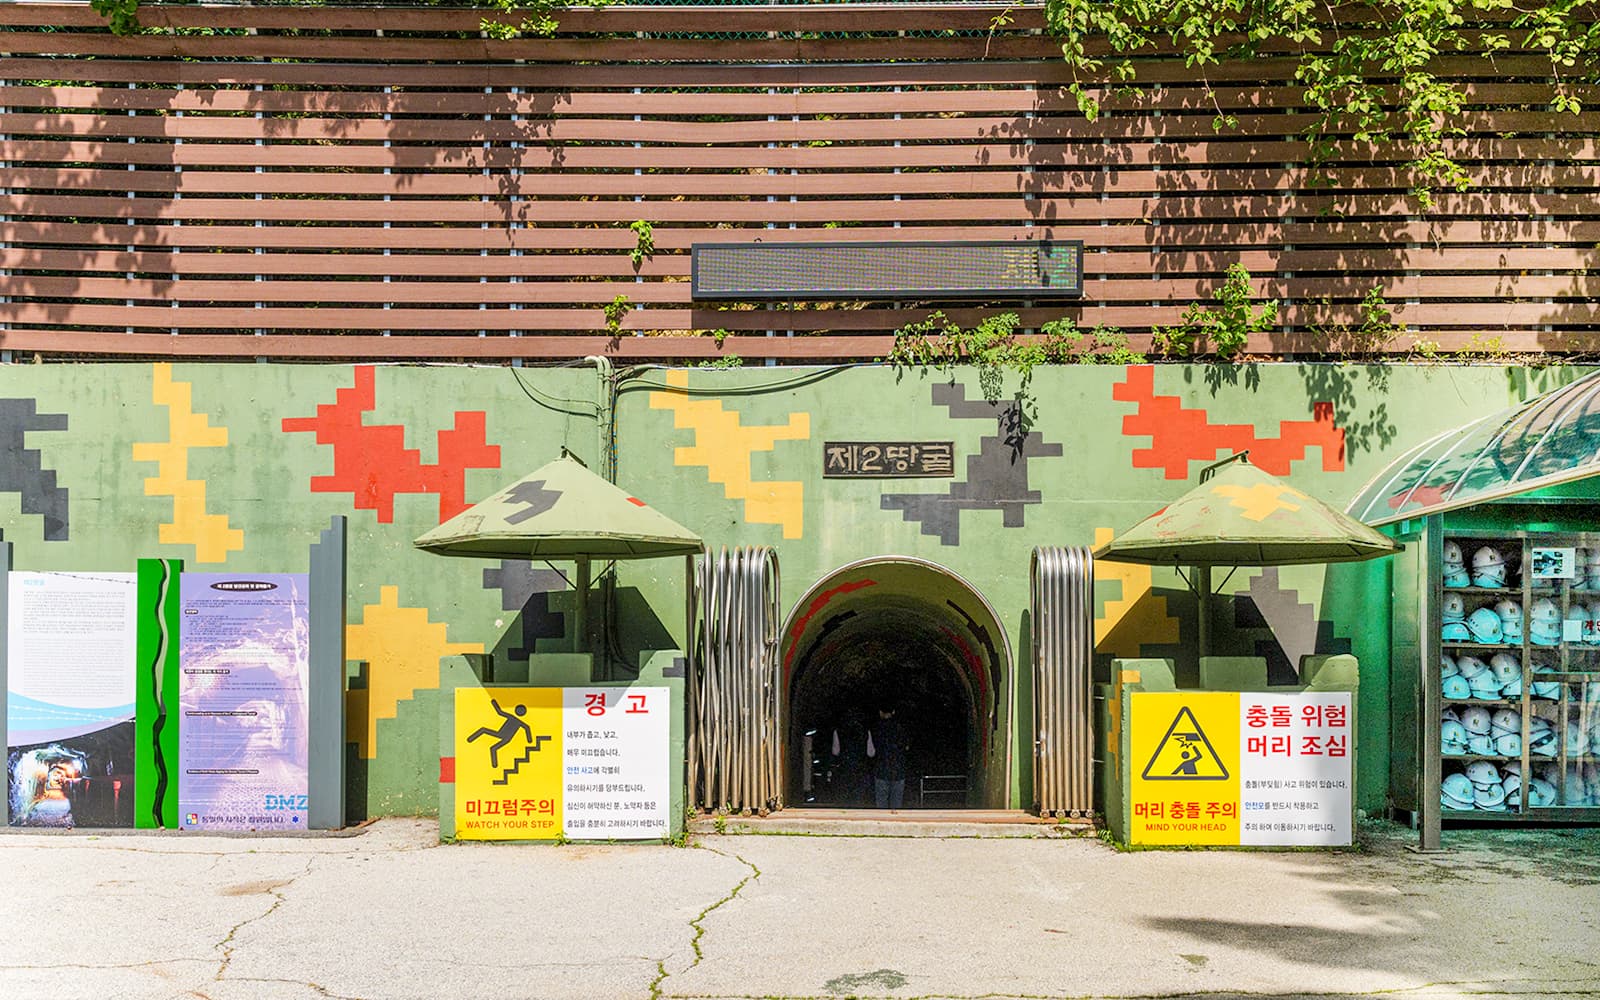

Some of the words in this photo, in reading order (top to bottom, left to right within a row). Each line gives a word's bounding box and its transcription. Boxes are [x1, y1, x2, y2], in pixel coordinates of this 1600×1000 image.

[827, 445, 951, 471] 제2땅굴
[1246, 705, 1292, 727] 충돌
[1301, 705, 1346, 727] 위험
[567, 731, 586, 739] 내부가
[603, 731, 619, 740] 낮고,
[1247, 735, 1291, 757] 머리
[1300, 735, 1346, 757] 조심
[567, 748, 580, 757] 매우
[567, 766, 580, 775] 안전
[581, 766, 600, 775] 사고에
[601, 766, 620, 775] 각별히
[567, 784, 604, 793] 유의하시기를
[606, 784, 646, 793] 당부드립니다.
[1284, 780, 1297, 789] 사고
[1319, 780, 1348, 789] 있습니다.
[264, 795, 309, 810] DMZ
[567, 801, 586, 810] 심신이
[587, 801, 613, 810] 허약하신
[624, 801, 643, 810] 노약자
[644, 801, 657, 810] 등은
[1245, 801, 1271, 810] 안전모를
[1272, 801, 1292, 810] 반드시
[1293, 801, 1319, 810] 착용하고
[466, 799, 555, 817] 미끄럼주의
[1135, 801, 1164, 819] 머리
[1169, 801, 1201, 819] 충돌
[1205, 801, 1237, 819] 주의
[466, 821, 500, 829] WATCH
[503, 821, 528, 829] YOUR
[531, 821, 555, 829] STEP
[567, 819, 586, 828] 출입을
[587, 819, 606, 828] 충분히
[607, 819, 639, 828] 고려하시기
[640, 819, 668, 828] 바랍니다.
[1145, 823, 1170, 832] MIND
[1172, 823, 1198, 832] YOUR
[1200, 823, 1227, 832] HEAD
[1245, 823, 1258, 832] 주의
[1259, 823, 1273, 832] 하여
[1274, 823, 1306, 832] 이동하시기
[1307, 823, 1337, 833] 바랍니다.
